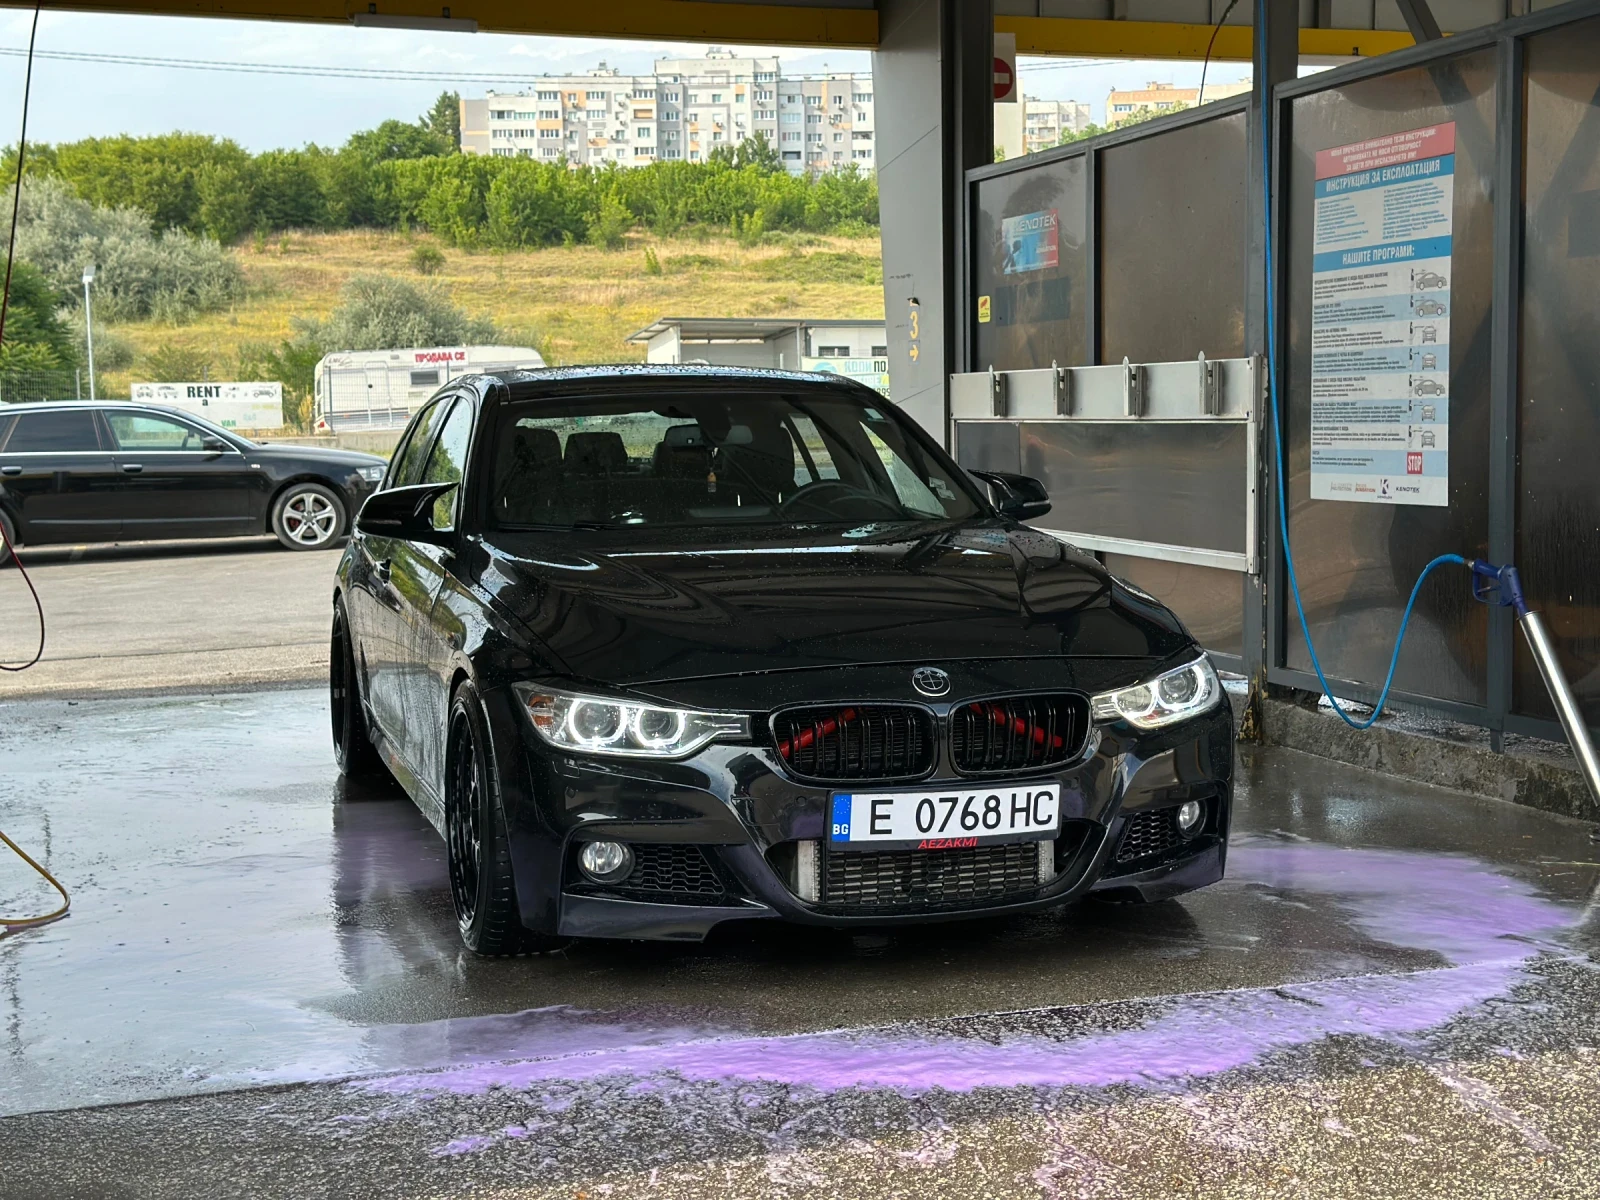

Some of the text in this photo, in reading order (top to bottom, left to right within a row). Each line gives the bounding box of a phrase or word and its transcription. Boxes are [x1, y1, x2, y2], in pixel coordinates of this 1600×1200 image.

[1326, 159, 1440, 192] ИНСТРУКЦИЯ ЗА ЕКСПЛОАТАЦИЯ
[1342, 244, 1415, 265] НАШИТЕ ПРОГРАМИ:
[909, 311, 919, 339] 3
[415, 351, 465, 363] ПРОДАВА СЕ
[874, 360, 889, 374] ПО
[187, 386, 222, 398] RENT
[221, 419, 236, 427] VAN
[1407, 455, 1422, 472] STOP
[869, 790, 1053, 835] E 0768 HC
[832, 823, 849, 835] BG
[917, 837, 978, 849] AEZAKMI
